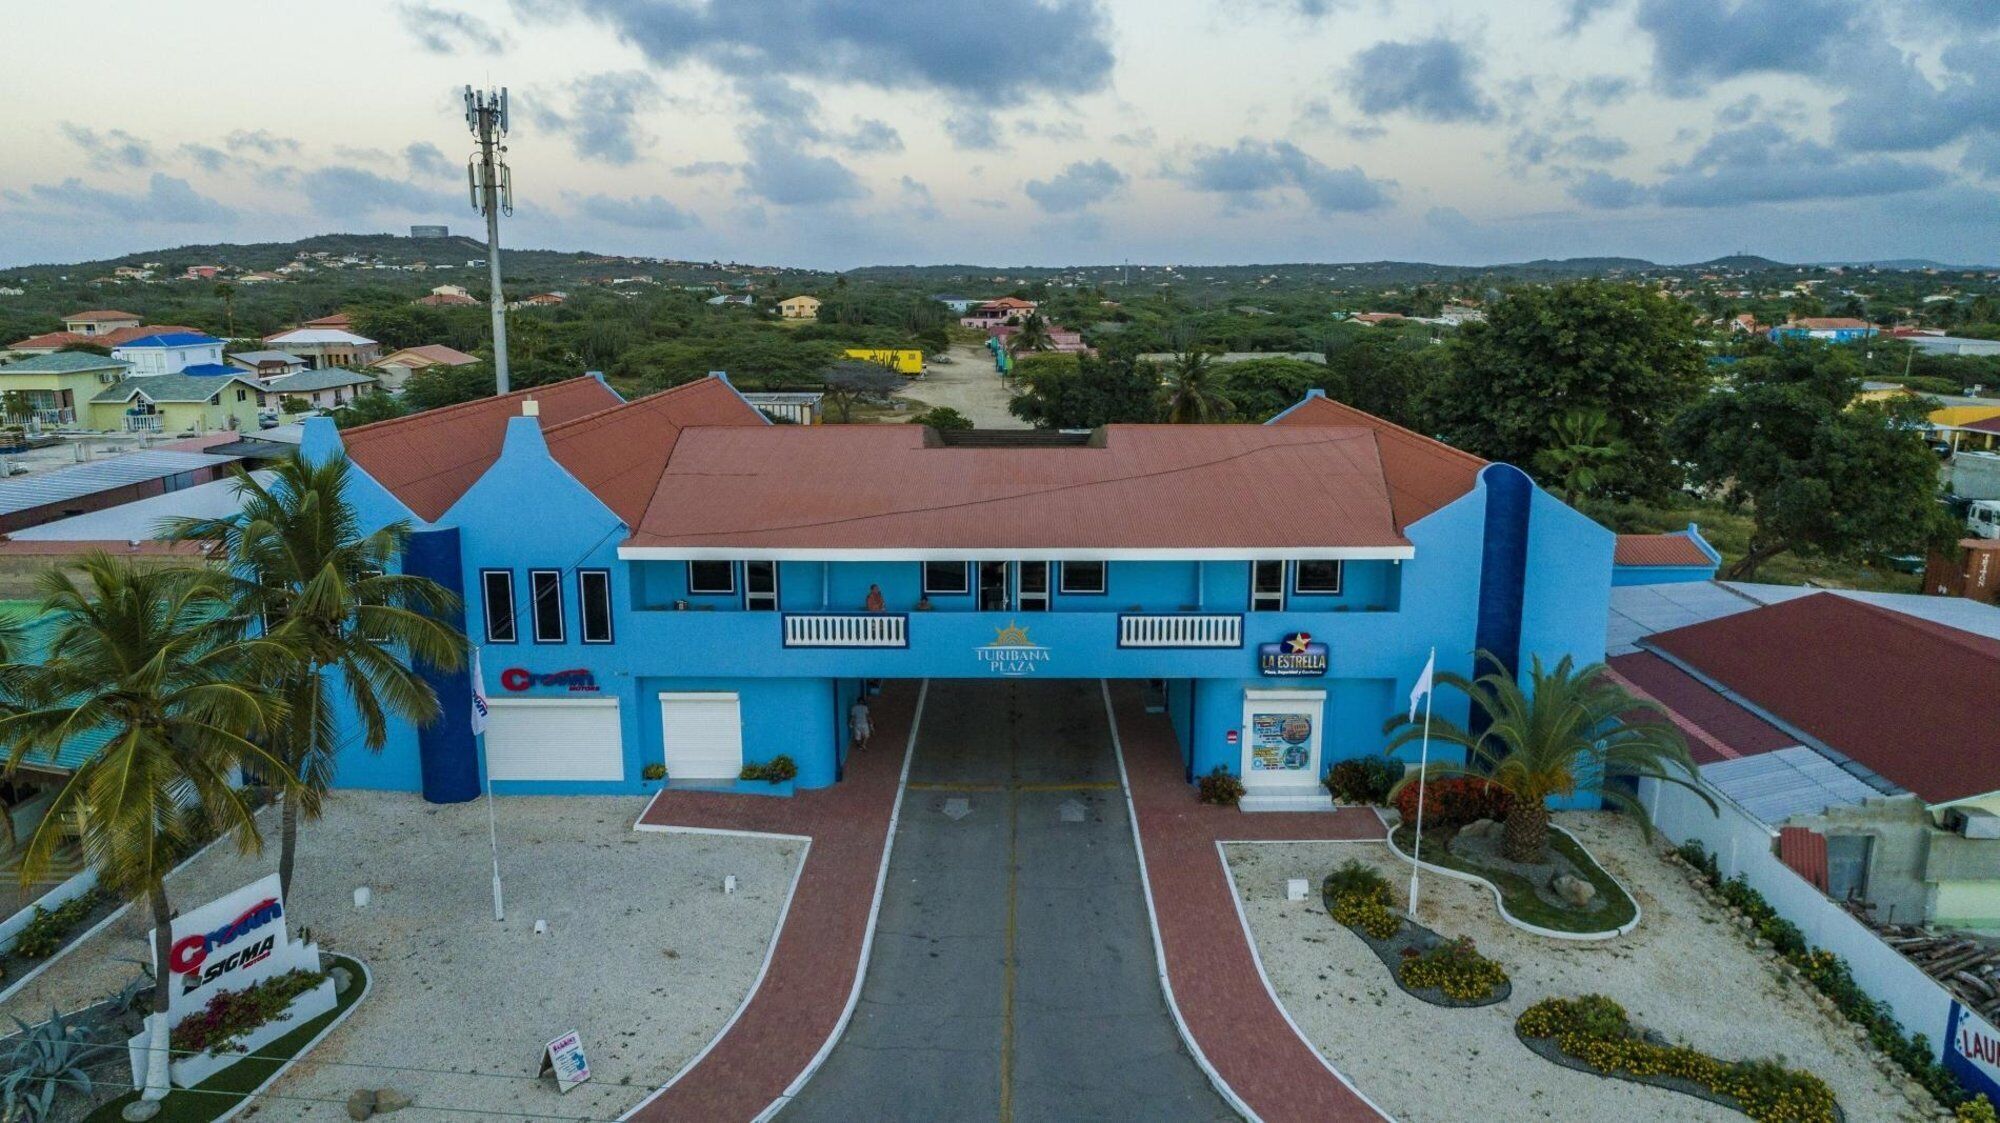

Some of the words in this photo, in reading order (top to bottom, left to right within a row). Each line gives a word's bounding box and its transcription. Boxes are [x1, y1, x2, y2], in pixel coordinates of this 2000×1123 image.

[976, 650, 1050, 661] TURIBANA
[1262, 655, 1275, 668] LA
[1277, 655, 1326, 668] ESTRELLA
[990, 661, 1035, 672] PLAZA
[500, 668, 595, 691] Crown
[170, 900, 282, 974] Crown
[202, 934, 275, 986] SIGMA
